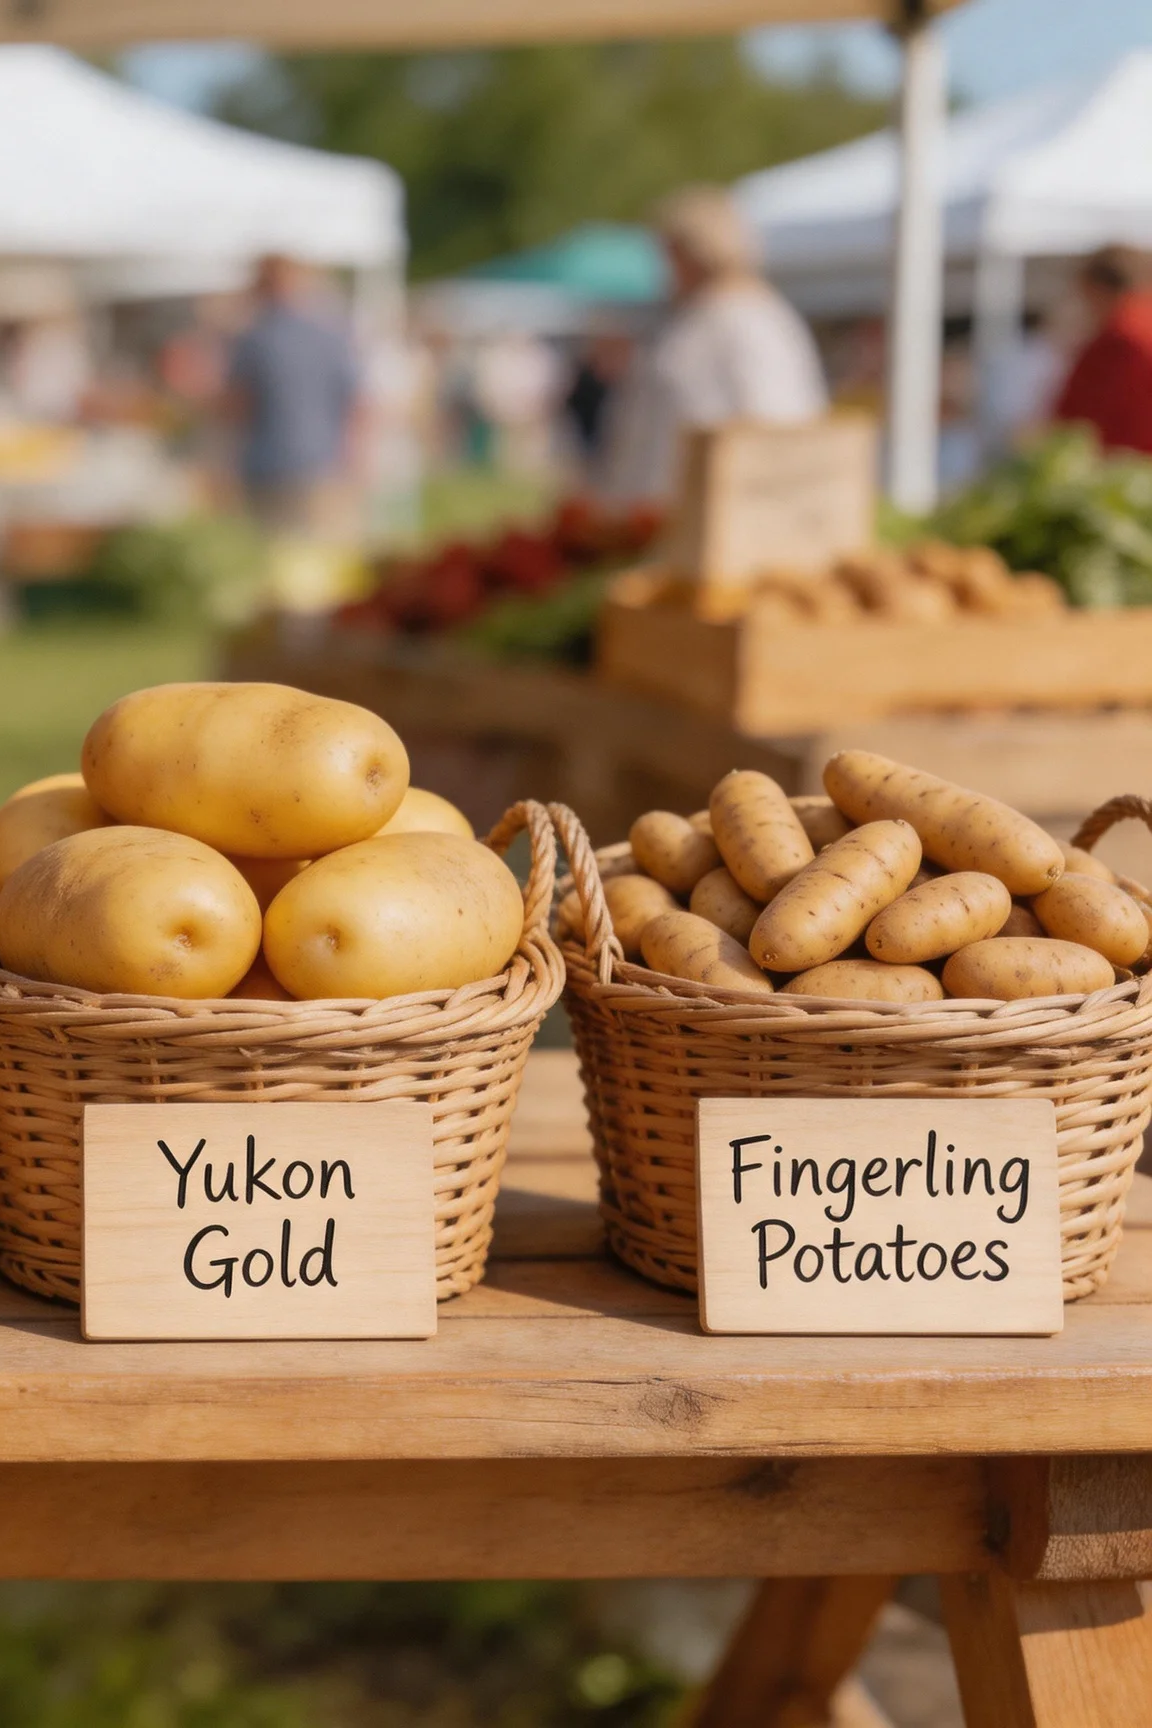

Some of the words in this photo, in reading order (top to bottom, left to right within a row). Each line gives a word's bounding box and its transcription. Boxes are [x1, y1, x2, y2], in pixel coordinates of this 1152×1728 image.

[156, 1134, 356, 1210] Yukon
[728, 1129, 1030, 1224] Fingerling
[183, 1217, 338, 1299] Gold
[751, 1218, 1010, 1290] Potatoes
